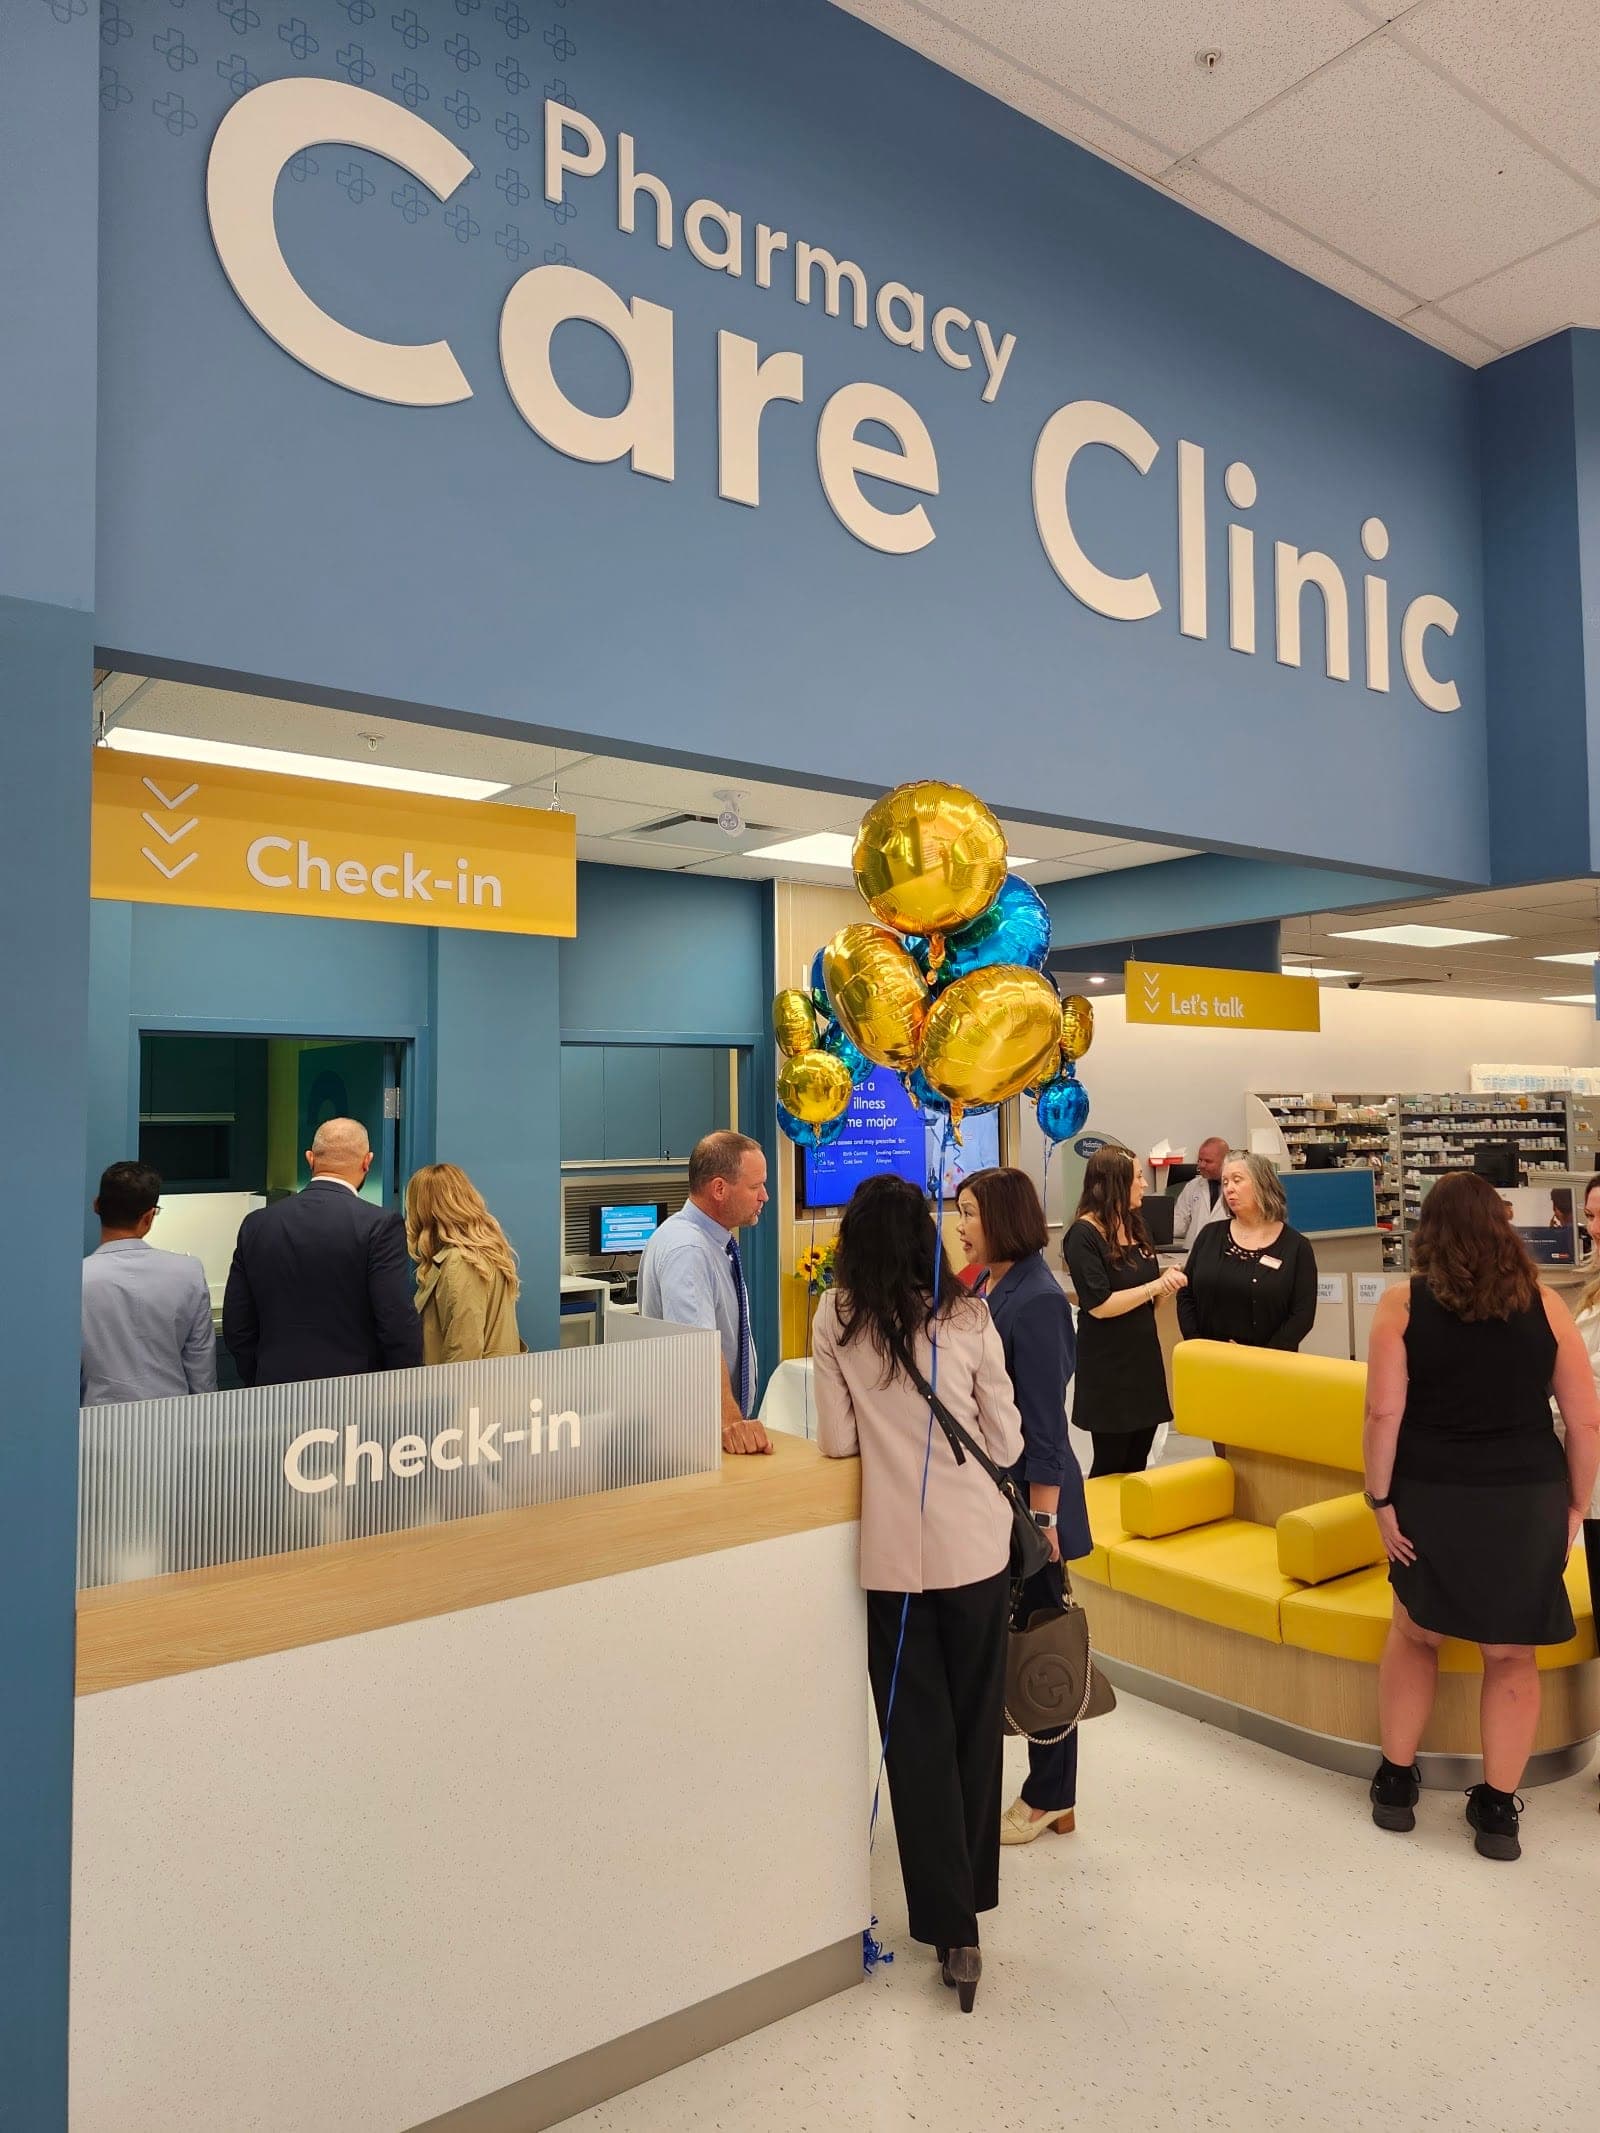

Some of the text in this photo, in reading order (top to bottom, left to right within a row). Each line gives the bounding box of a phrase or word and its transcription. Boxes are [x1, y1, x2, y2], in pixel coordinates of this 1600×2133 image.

[543, 98, 1018, 403] Pharmacy
[205, 75, 1463, 714] Care Clinic
[246, 835, 504, 909] Check-in
[1170, 992, 1245, 1018] Let's talk
[867, 1082, 876, 1091] a
[853, 1096, 886, 1110] illness
[847, 1115, 898, 1130] me major
[1359, 1290, 1375, 1298] ONLY
[283, 1397, 582, 1494] Check-in
